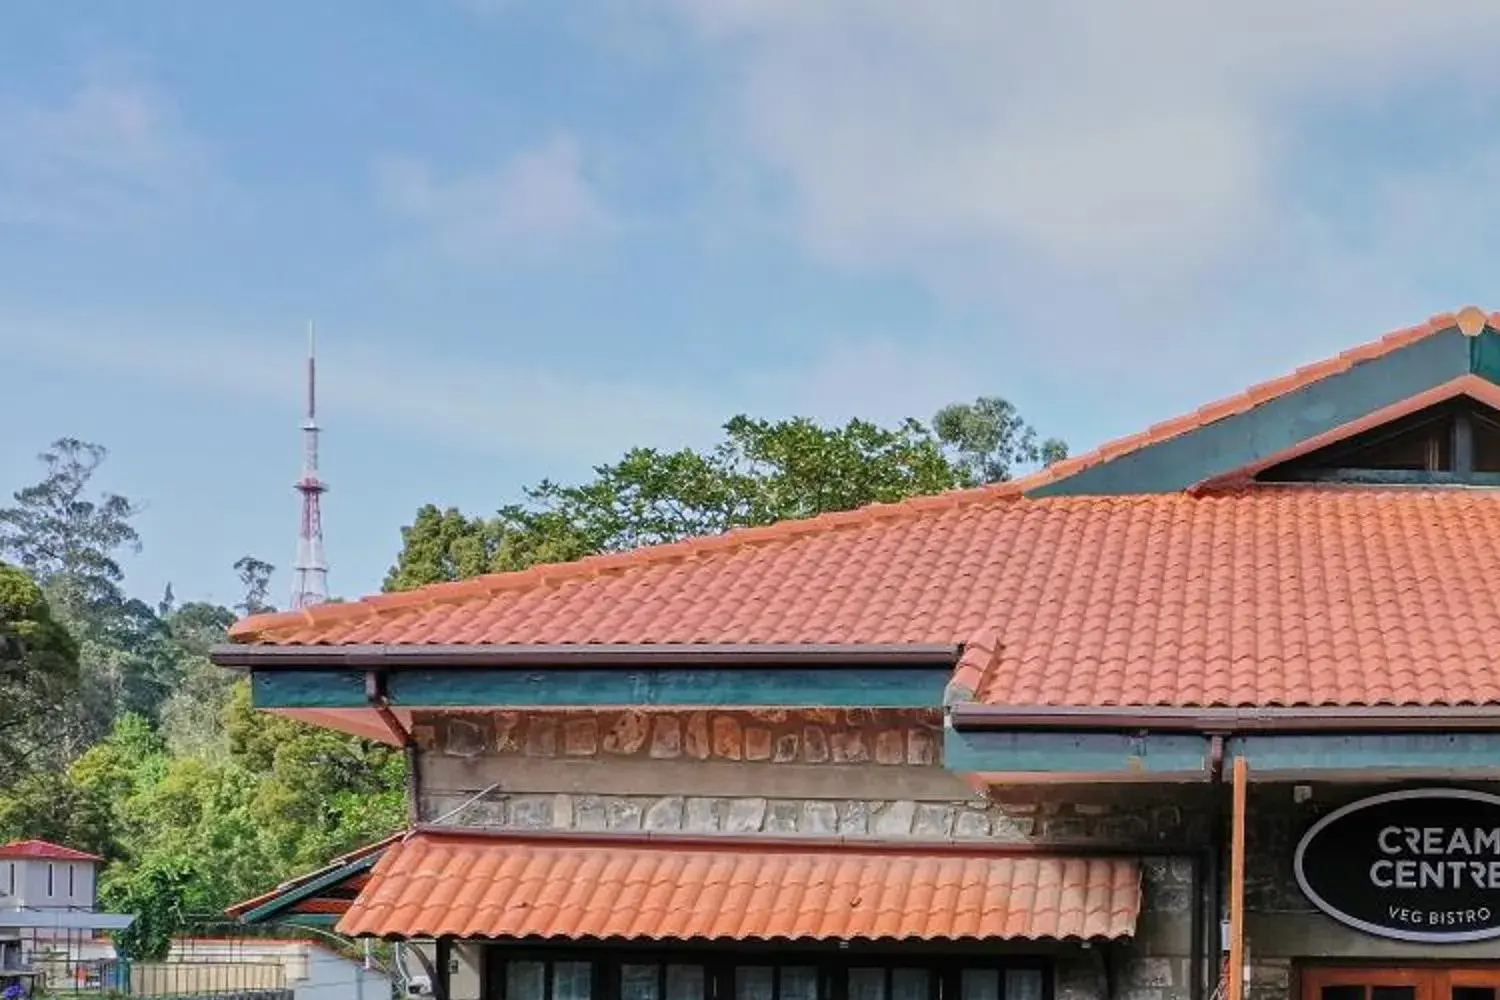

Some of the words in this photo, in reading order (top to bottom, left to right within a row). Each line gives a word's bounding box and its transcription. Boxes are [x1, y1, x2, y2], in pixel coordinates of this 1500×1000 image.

[1378, 826, 1500, 854] CREAM
[1389, 905, 1423, 924] VEG
[1429, 907, 1491, 925] BISTRO
